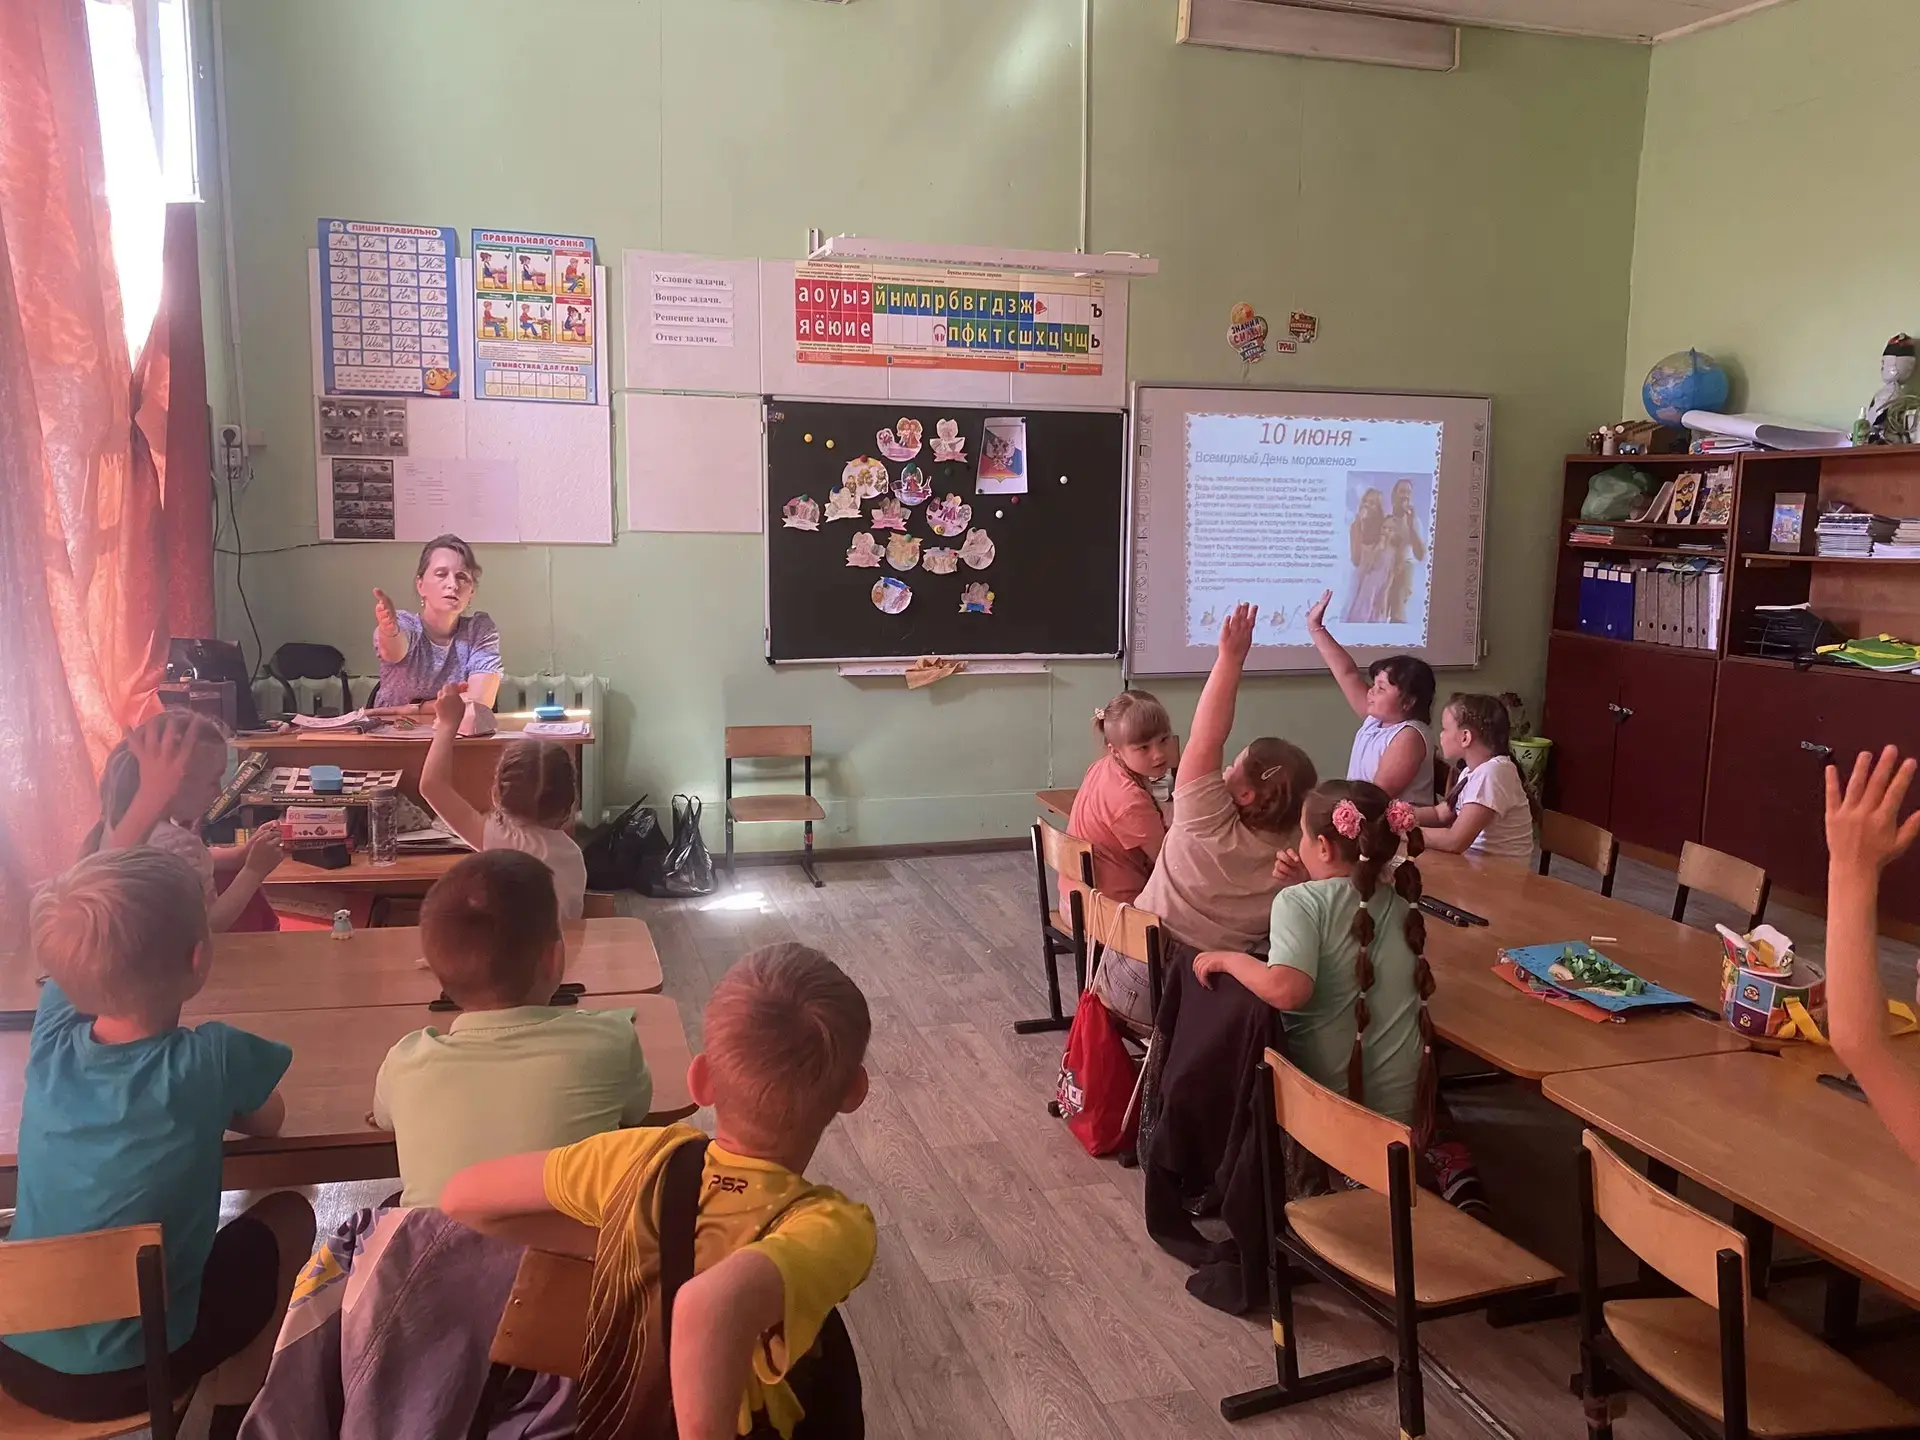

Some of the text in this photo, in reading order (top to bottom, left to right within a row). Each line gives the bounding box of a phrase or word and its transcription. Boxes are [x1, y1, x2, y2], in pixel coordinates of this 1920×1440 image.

[351, 224, 438, 236] ПИШИ ПРАВИЛЬНО
[482, 233, 585, 247] ПРАВИЛЬНАЯ ОСАНКА
[655, 273, 727, 287] Условие задачи.
[655, 292, 687, 303] Вопрос
[655, 313, 694, 323] Решение
[655, 333, 717, 344] Ответ задачи.
[492, 361, 541, 370] ГИМНАСТИКА
[1259, 422, 1286, 445] 10
[1293, 428, 1352, 447] июня
[1195, 451, 1357, 468] Всемирный День мороженого
[231, 766, 254, 791] НАРДЫ
[207, 793, 231, 820] ШАШКИ
[289, 812, 300, 820] 60
[707, 1174, 749, 1195] PSR
